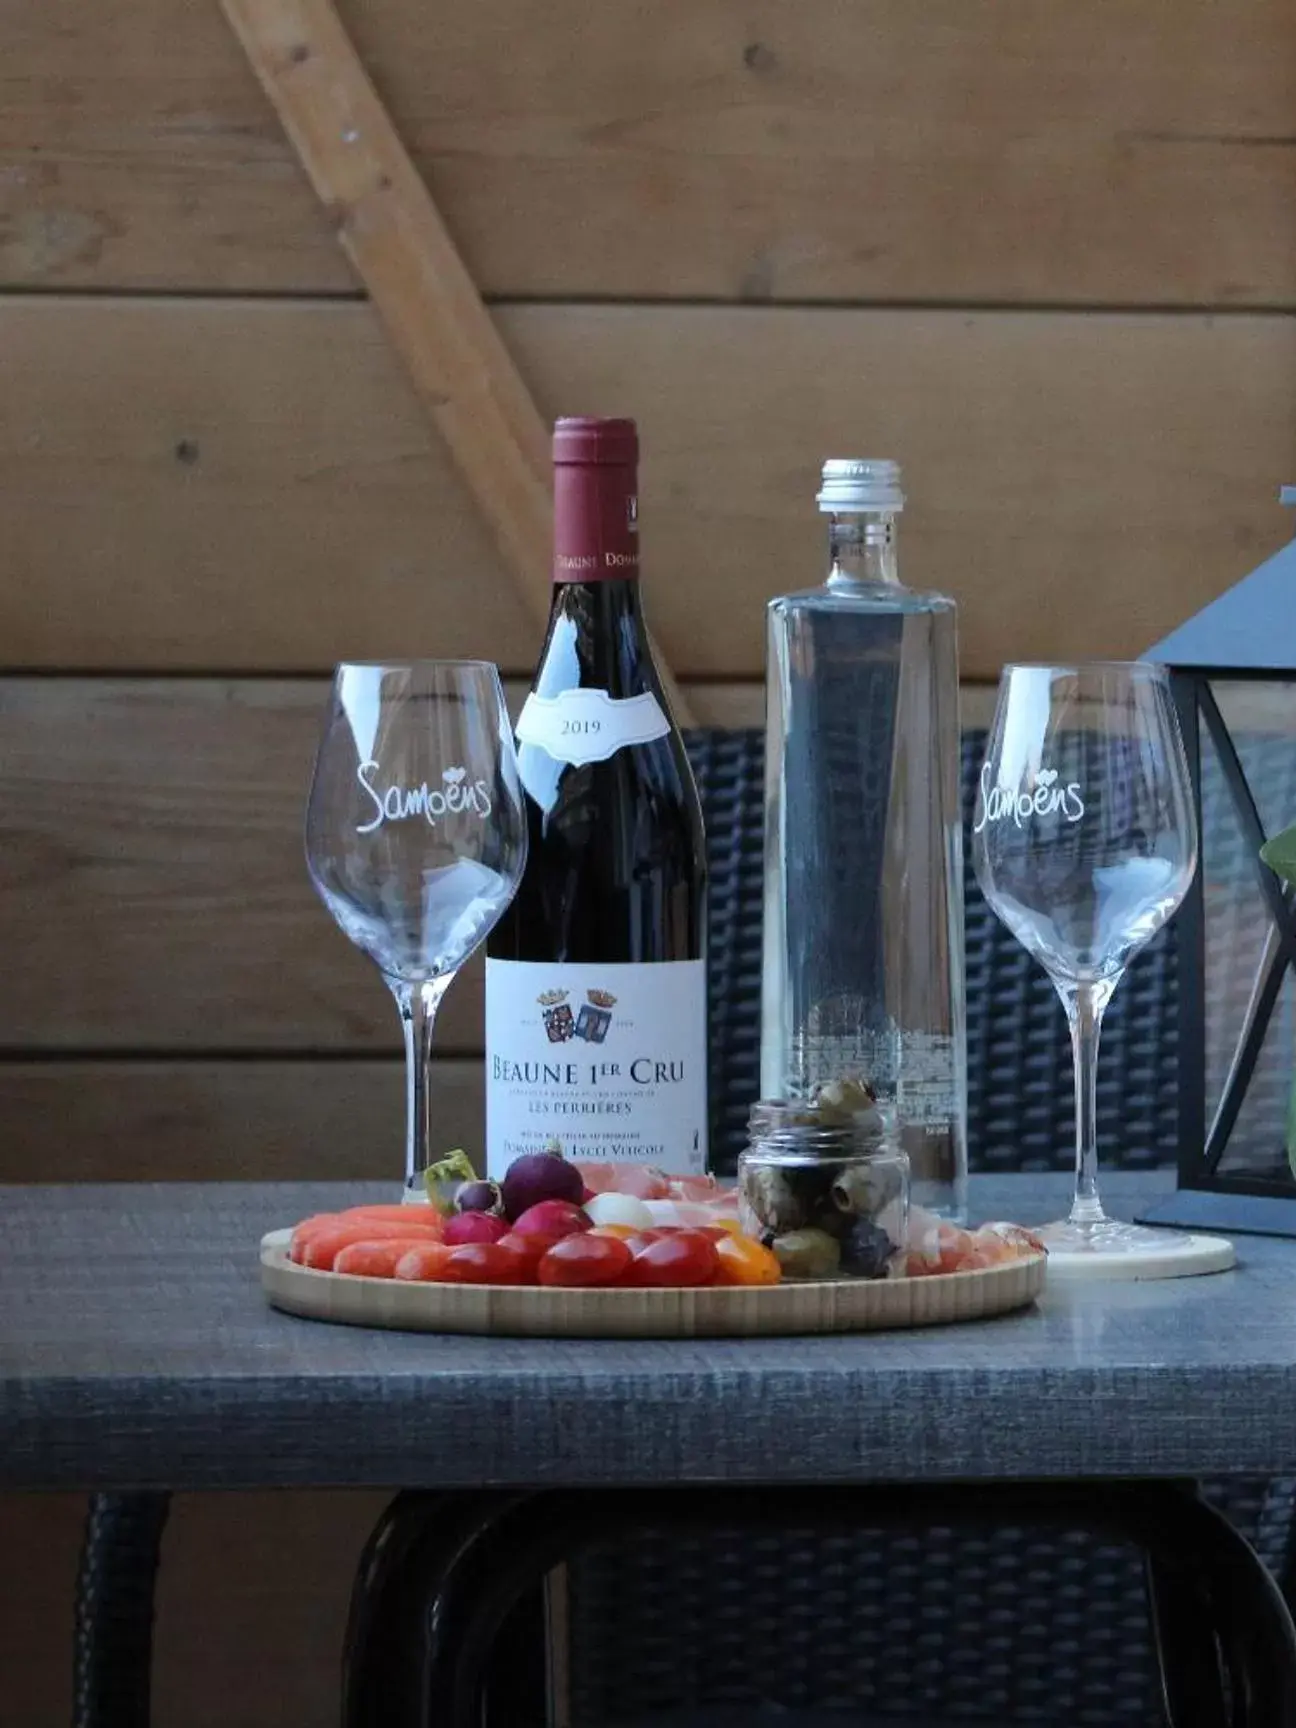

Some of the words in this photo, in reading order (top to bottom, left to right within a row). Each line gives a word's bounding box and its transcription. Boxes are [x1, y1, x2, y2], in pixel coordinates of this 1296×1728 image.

[561, 719, 601, 735] 2019
[493, 1054, 578, 1085] BEAUNE
[629, 1057, 685, 1085] CRU
